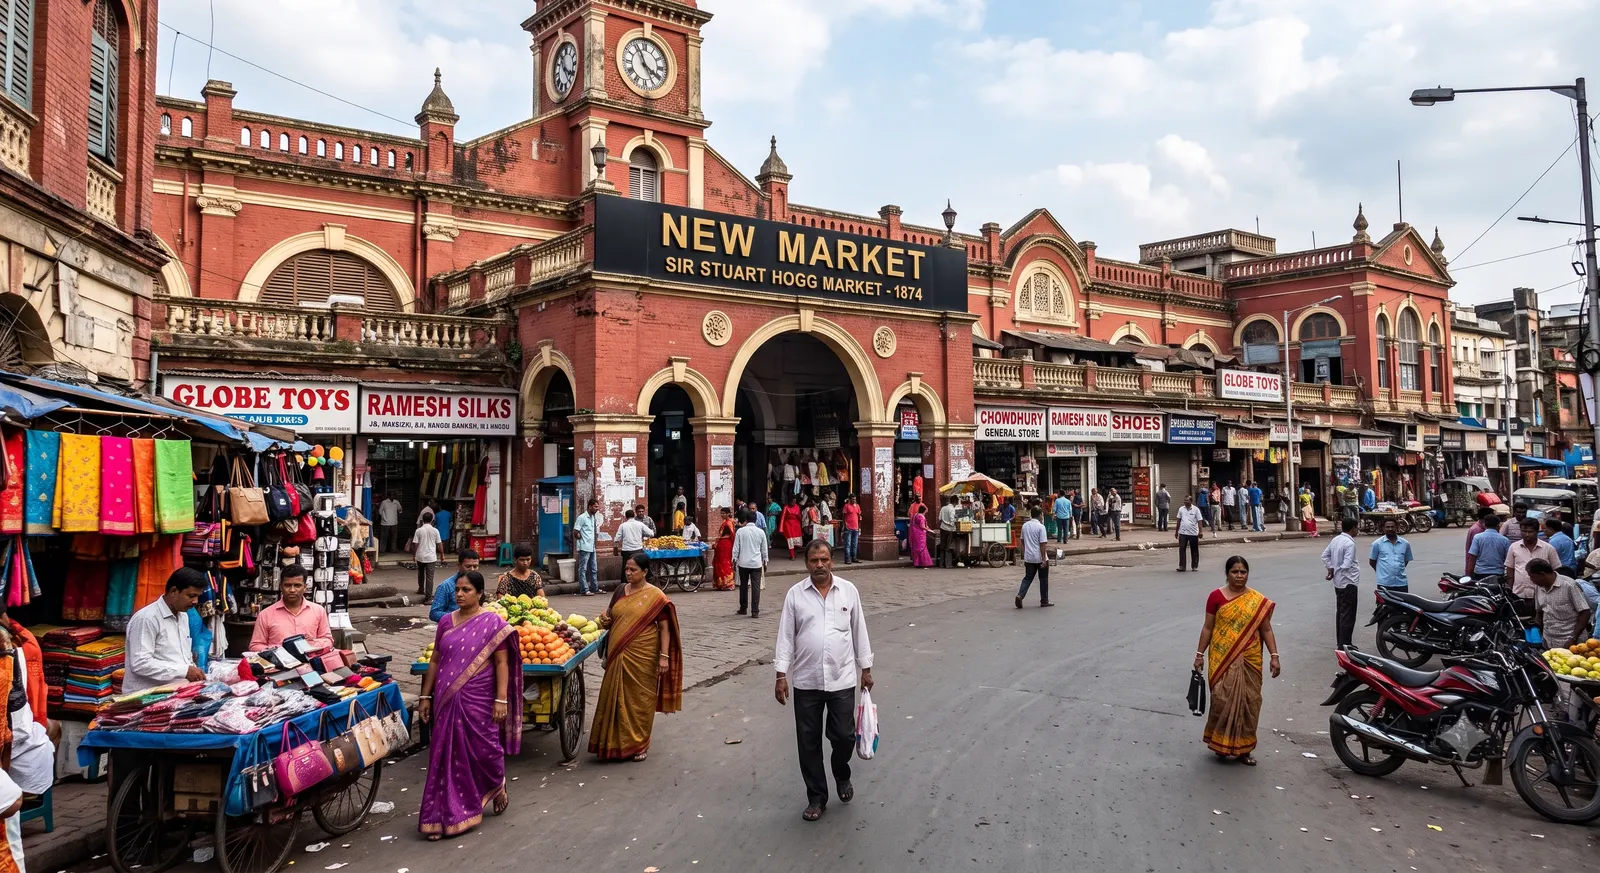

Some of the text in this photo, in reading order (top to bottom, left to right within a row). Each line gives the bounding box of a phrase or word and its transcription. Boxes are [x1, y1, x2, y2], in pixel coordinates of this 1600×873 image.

[662, 211, 926, 280] NEW MARKET
[665, 256, 695, 275] SIR
[700, 260, 766, 283] STUART
[772, 269, 818, 288] HOGG
[822, 276, 883, 296] MARKET
[1224, 373, 1279, 391] GLOBE TOYS
[172, 383, 351, 412] GLOBE TOYS
[367, 393, 512, 419] RAMESH SILKS
[980, 410, 1043, 426] CHOWDHURY
[1051, 412, 1108, 427] RAMESH SILKS
[1111, 415, 1161, 431] SHOES
[984, 427, 1017, 438] GENERAL
[1018, 428, 1040, 438] STORE
